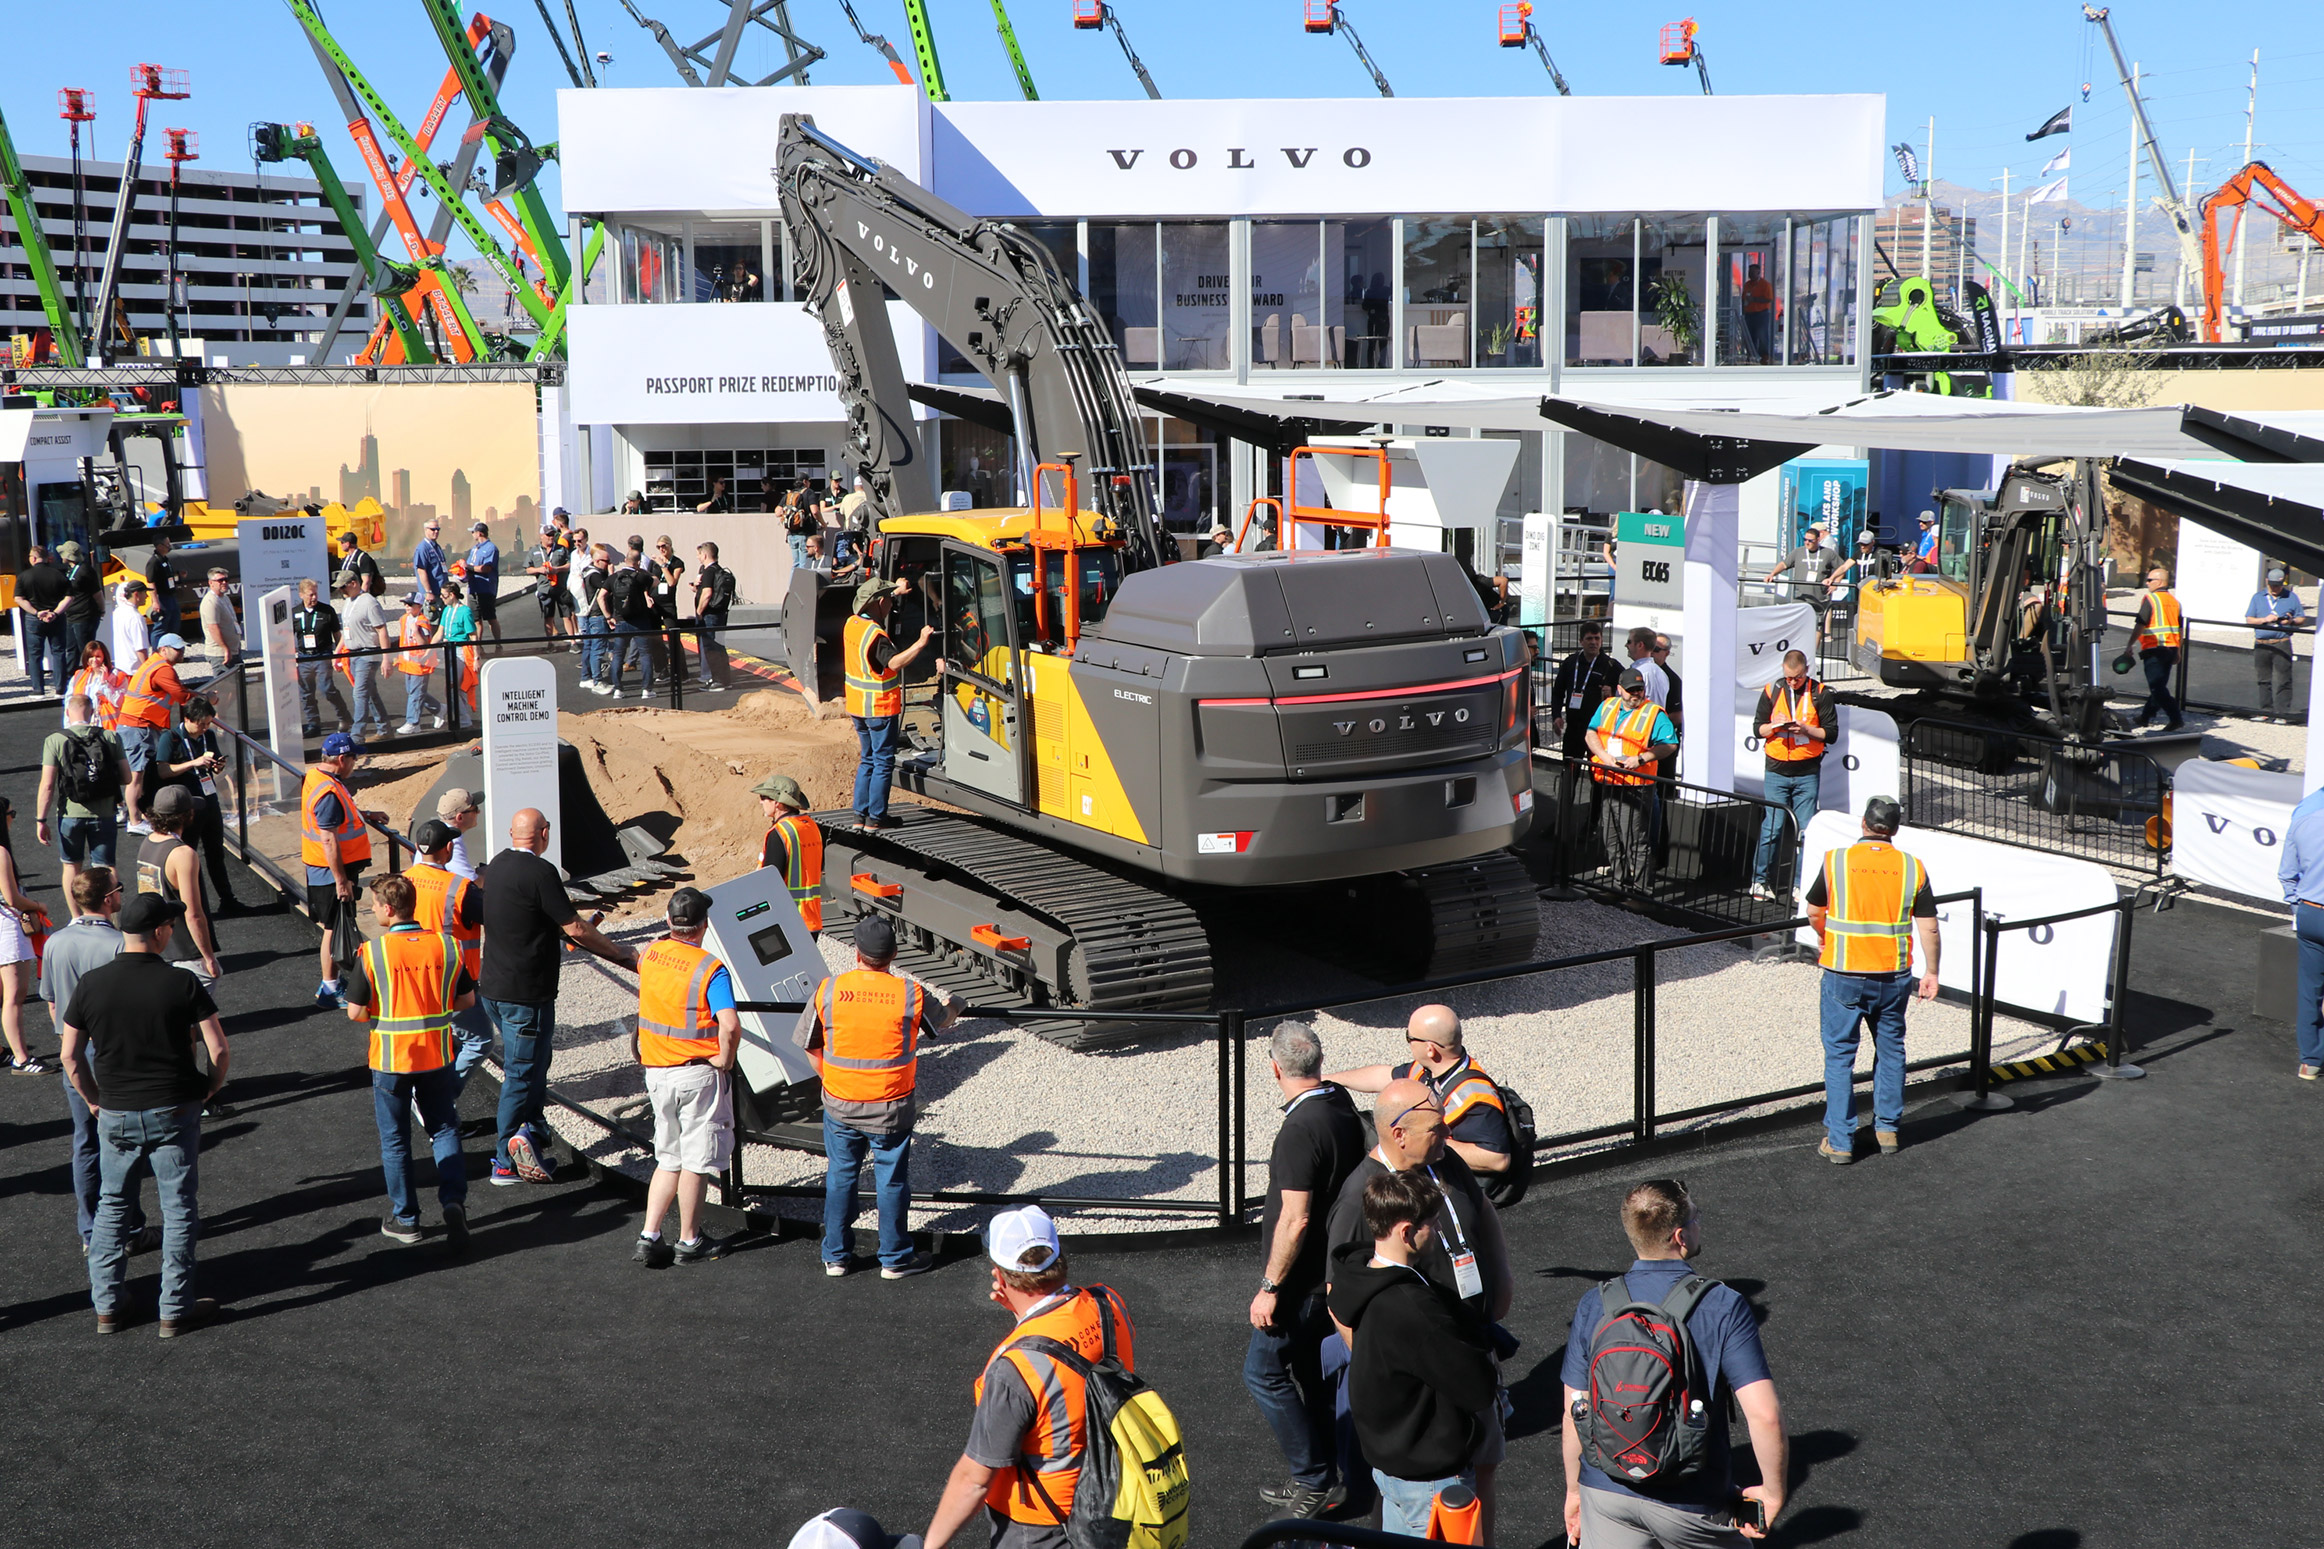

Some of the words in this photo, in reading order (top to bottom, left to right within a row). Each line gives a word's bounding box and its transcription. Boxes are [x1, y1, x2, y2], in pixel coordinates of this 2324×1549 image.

[422, 95, 448, 137] BA44RT
[1106, 147, 1371, 170] VOLVO
[857, 220, 934, 289] VOLVO
[486, 251, 522, 294] MERLO
[1198, 275, 1230, 288] DRIVE
[1176, 294, 1228, 307] BUSINESS
[1252, 293, 1284, 307] WARD
[386, 297, 409, 332] ERLO
[432, 288, 462, 336] BT44ERT
[1980, 310, 1997, 352] RAGNA
[646, 376, 714, 394] PASSPORT
[719, 376, 757, 393] PRIZE
[761, 375, 840, 392] REDEMPTIO
[29, 436, 54, 446] COMPACT
[54, 435, 72, 445] ASSIST
[1823, 480, 1832, 502] AND
[1822, 502, 1831, 532] ALKS
[262, 525, 306, 540] DD120C
[1644, 523, 1671, 538] NEW
[502, 689, 545, 701] INTELLIGENT
[1113, 688, 1152, 705] ELECTRIC
[507, 701, 539, 711] MACHINE
[497, 712, 528, 723] CONTROL
[530, 711, 550, 721] DEMO
[1333, 707, 1470, 736] VOLVO
[1851, 868, 1899, 876] VOLVO
[659, 953, 691, 966] CONEXPO
[856, 991, 896, 999] CONEXPO
[856, 997, 896, 1005] CON/AGG
